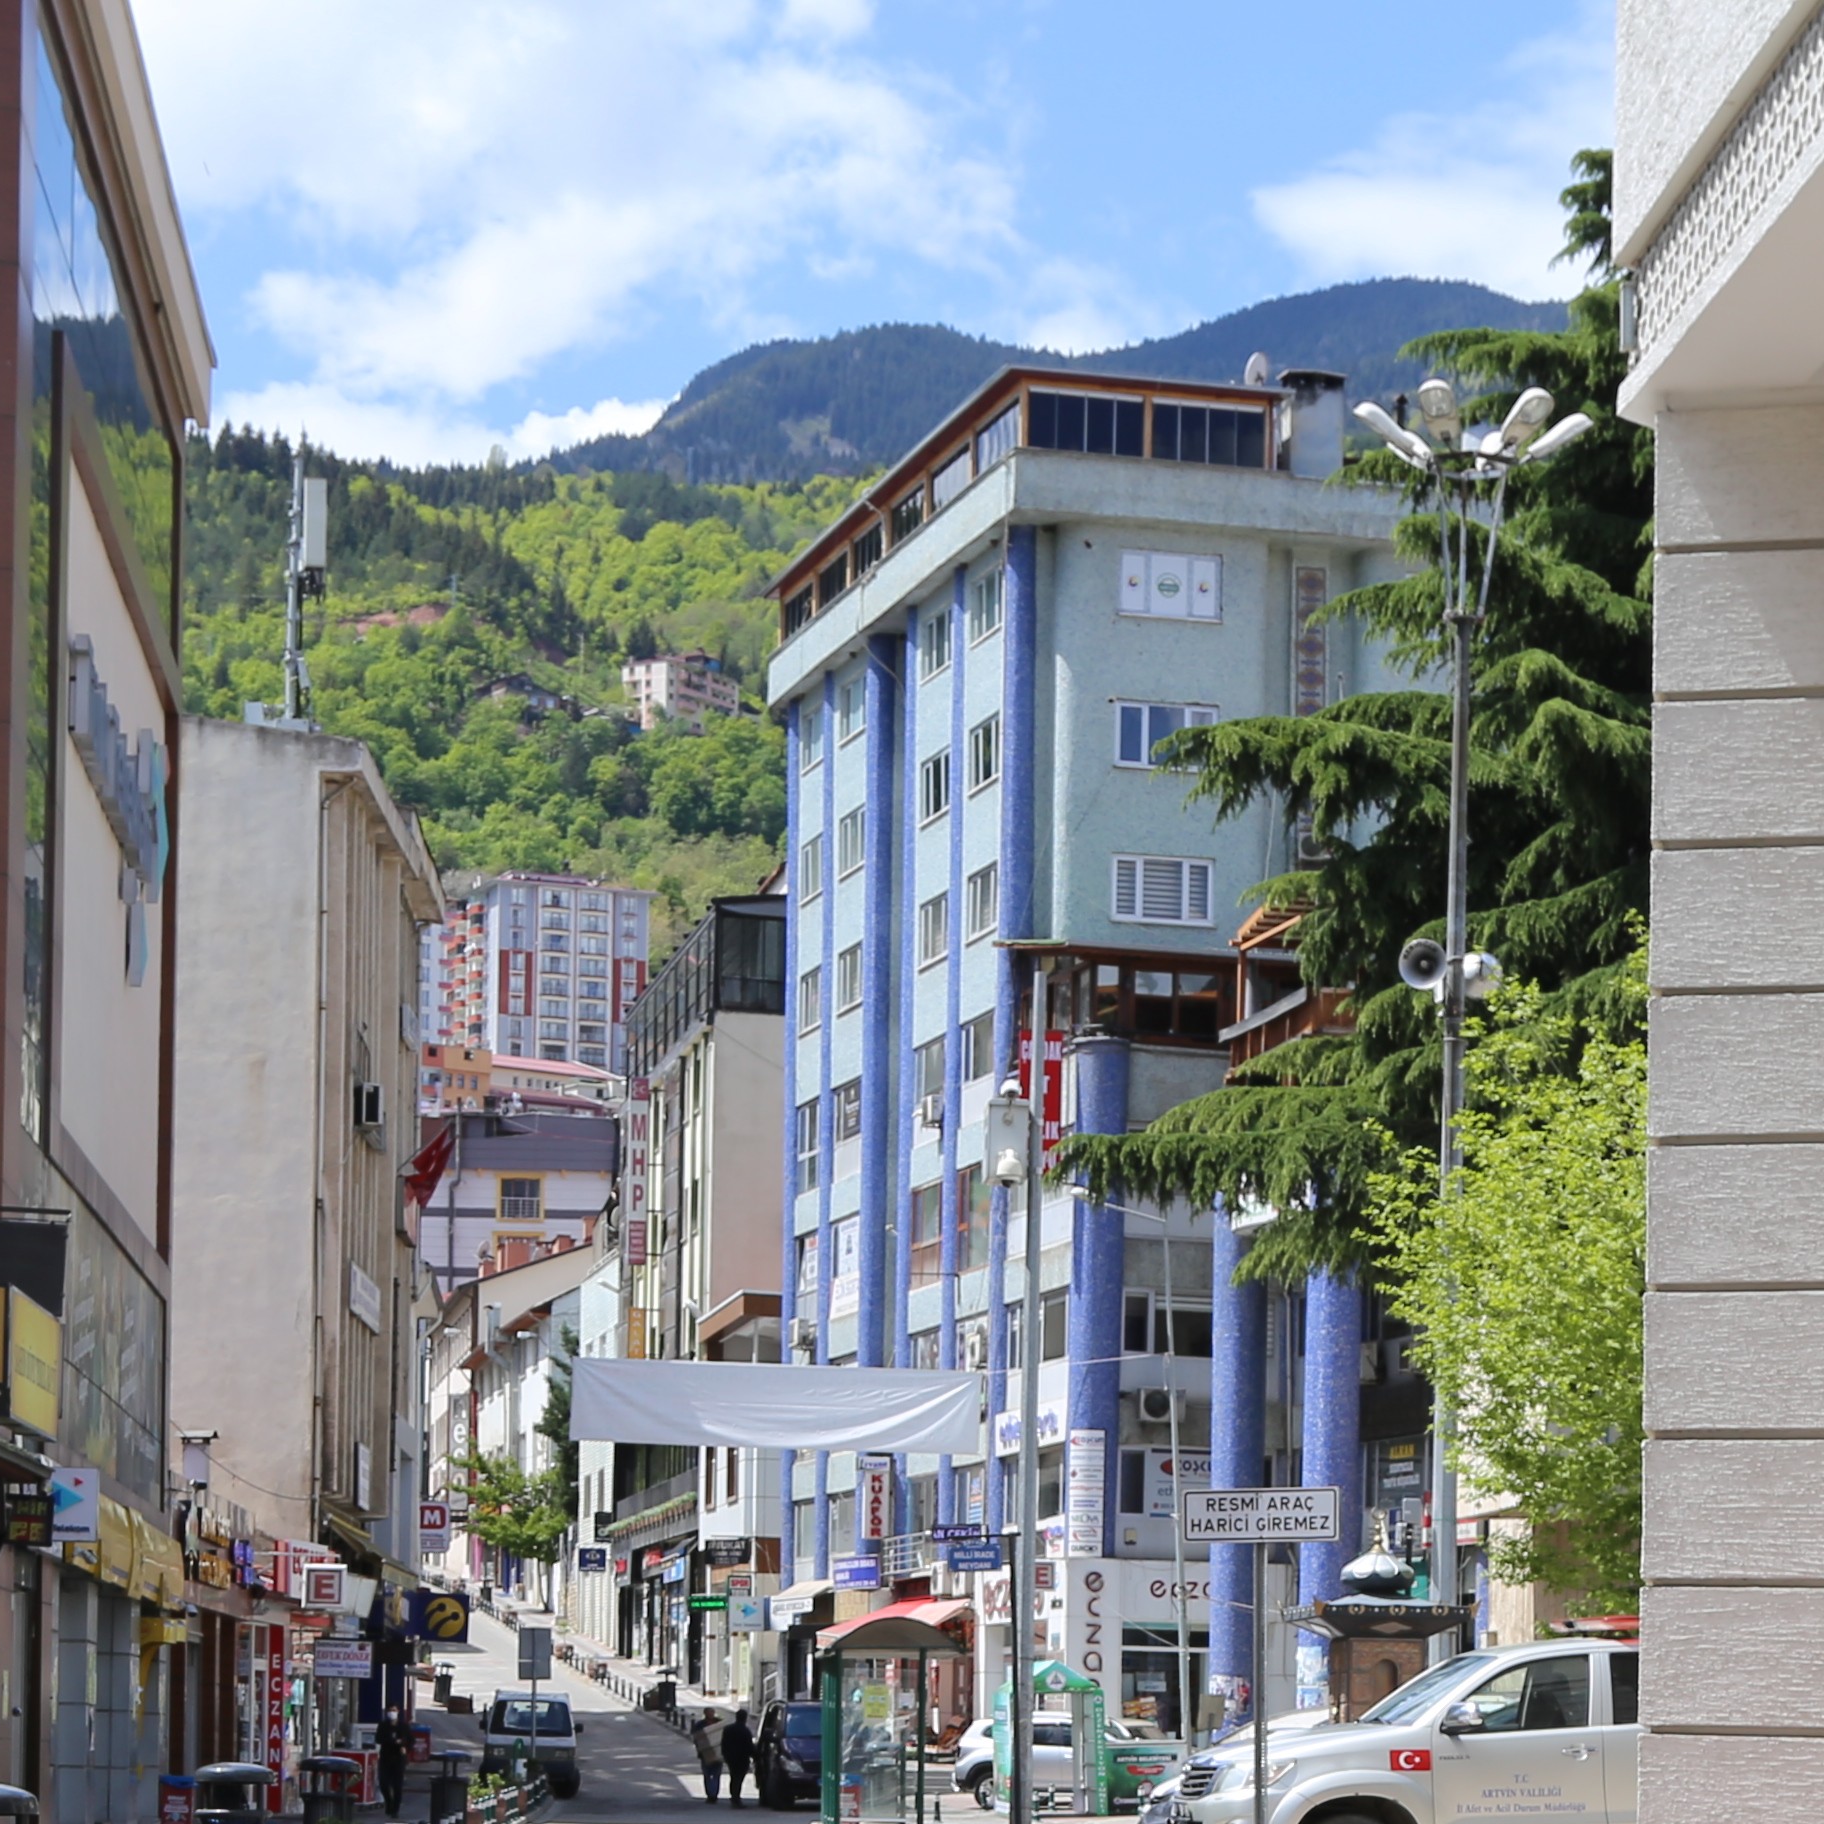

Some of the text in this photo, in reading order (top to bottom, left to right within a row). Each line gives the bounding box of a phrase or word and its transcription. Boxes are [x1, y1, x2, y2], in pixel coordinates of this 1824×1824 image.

[631, 1112, 647, 1212] MHP
[1206, 1492, 1314, 1512] RESMİ ARAÇ
[1190, 1513, 1330, 1532] HARİCİ GİREMEZ
[1035, 1566, 1049, 1585] E
[314, 1574, 335, 1599] E
[269, 1653, 281, 1787] ECZANE
[1481, 1787, 1517, 1799] ARTVİN
[1464, 1804, 1481, 1813] Afet
[1495, 1803, 1511, 1813] Acil
